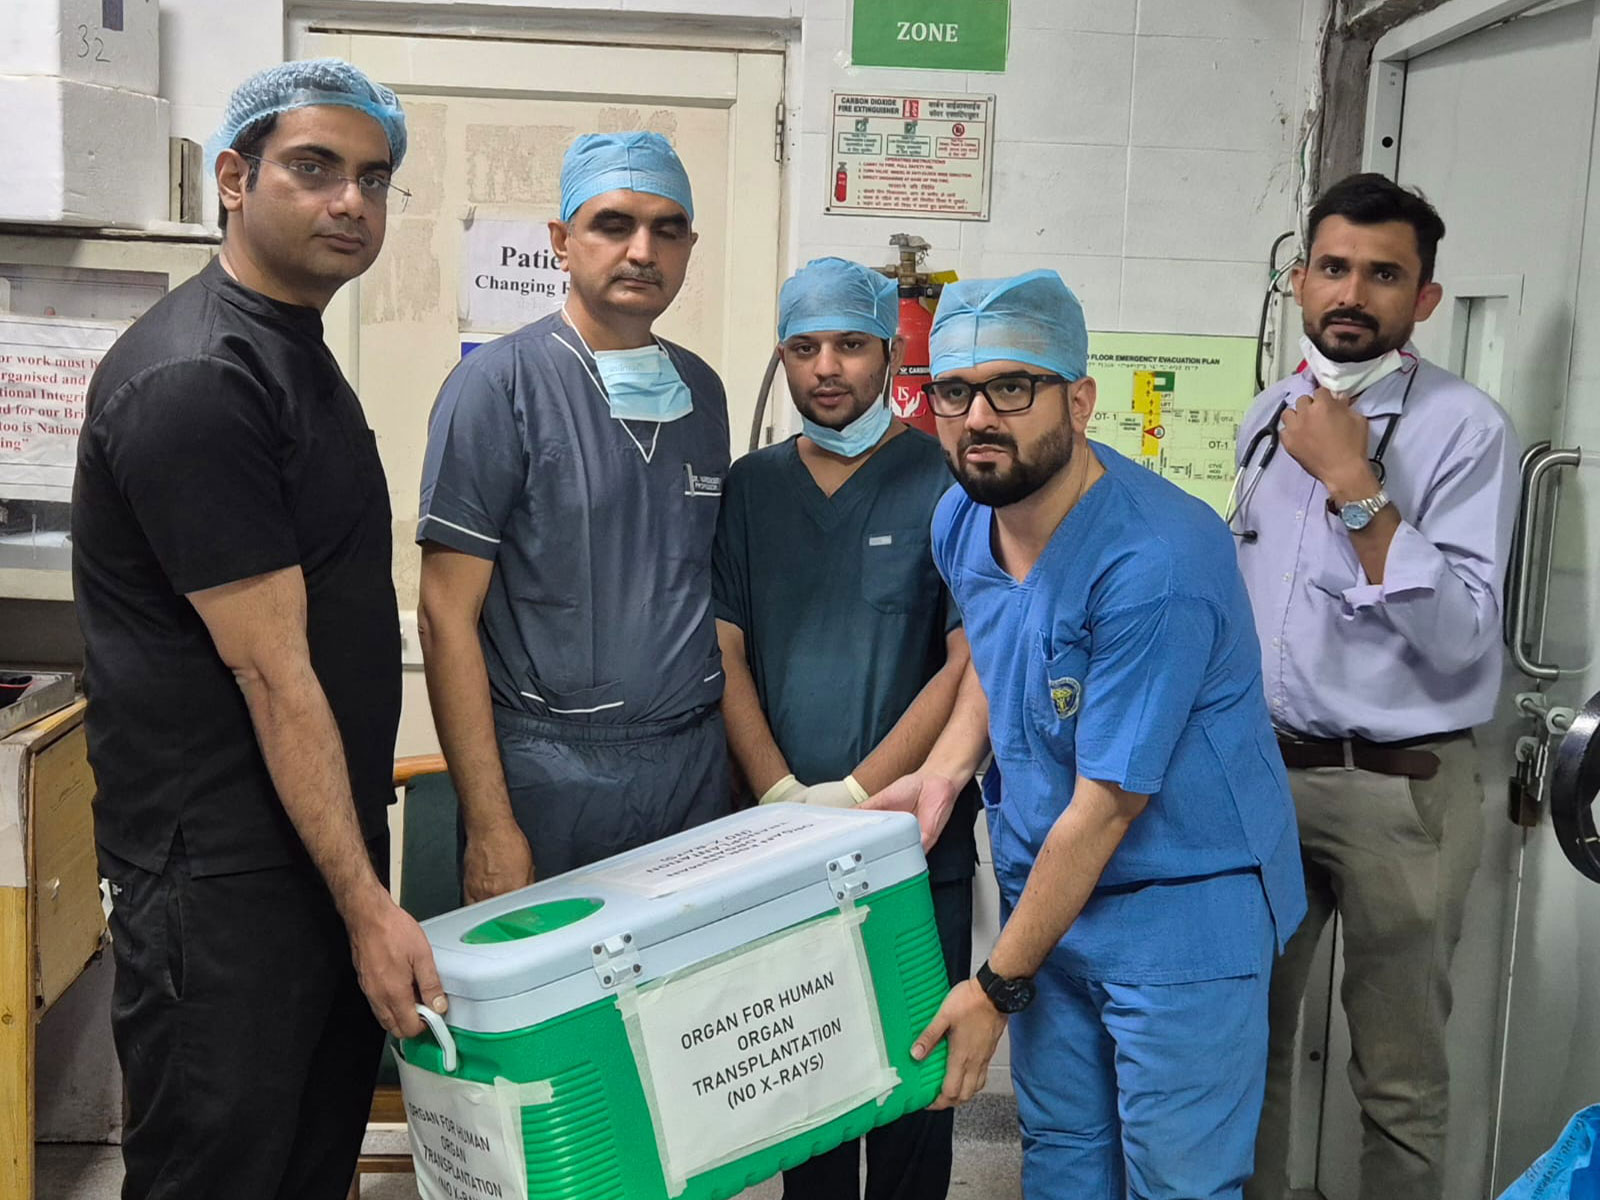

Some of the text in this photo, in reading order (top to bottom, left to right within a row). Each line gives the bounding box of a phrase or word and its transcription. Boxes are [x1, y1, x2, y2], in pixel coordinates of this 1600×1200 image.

[77, 24, 111, 62] 32
[897, 22, 958, 42] ZONE
[854, 106, 900, 114] EXTINGUISHER
[475, 274, 556, 298] Changing
[17, 355, 50, 366] work
[56, 358, 85, 369] must
[1116, 354, 1158, 363] EMERGENCY
[1160, 356, 1201, 364] EVACUATION
[62, 374, 86, 385] and
[16, 404, 34, 415] for
[38, 408, 60, 418] our
[23, 421, 32, 433] is
[1208, 440, 1228, 450] OT-1
[681, 971, 834, 1050] ORGAN FOR HUMAN
[737, 1015, 794, 1051] ORGAN
[692, 1017, 842, 1096] TRANSPLANTATION
[727, 1052, 824, 1110] (NO X-RAYS)
[408, 1102, 490, 1152] ORGAN FOR HUMAN
[440, 1136, 467, 1164] ORGAN
[423, 1144, 502, 1198] TRANSPLANTATION
